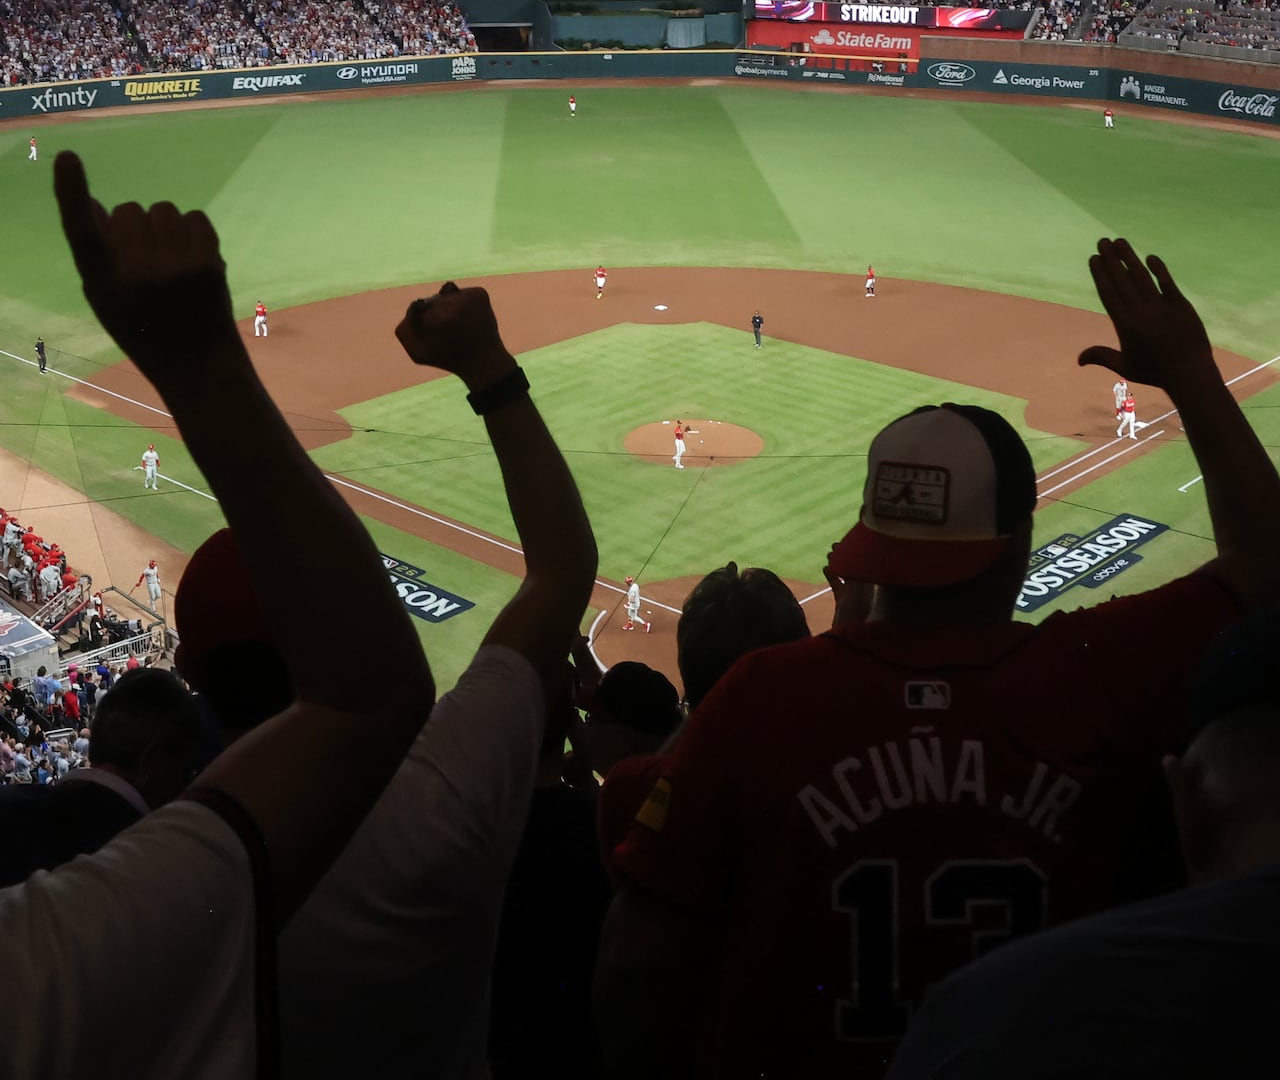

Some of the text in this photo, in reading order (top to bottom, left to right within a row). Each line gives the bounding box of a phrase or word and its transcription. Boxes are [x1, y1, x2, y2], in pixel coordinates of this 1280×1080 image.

[840, 4, 919, 24] STRIKEOUT
[361, 63, 419, 77] HYUNDAI
[452, 56, 476, 68] PAPA
[451, 66, 477, 75] JOHNS
[935, 64, 967, 80] Ford
[232, 74, 304, 91] EQUIFAX
[875, 74, 906, 84] National
[1010, 74, 1085, 89] Georgia Power
[124, 79, 201, 97] QUIKRETE
[1144, 84, 1166, 94] KAISER
[30, 87, 98, 113] xfinity
[1143, 93, 1187, 106] PERMANENTE
[1218, 89, 1280, 118] Coca-Cola
[1093, 559, 1129, 581] abbvie
[797, 725, 1083, 848] ACUÑA JR.
